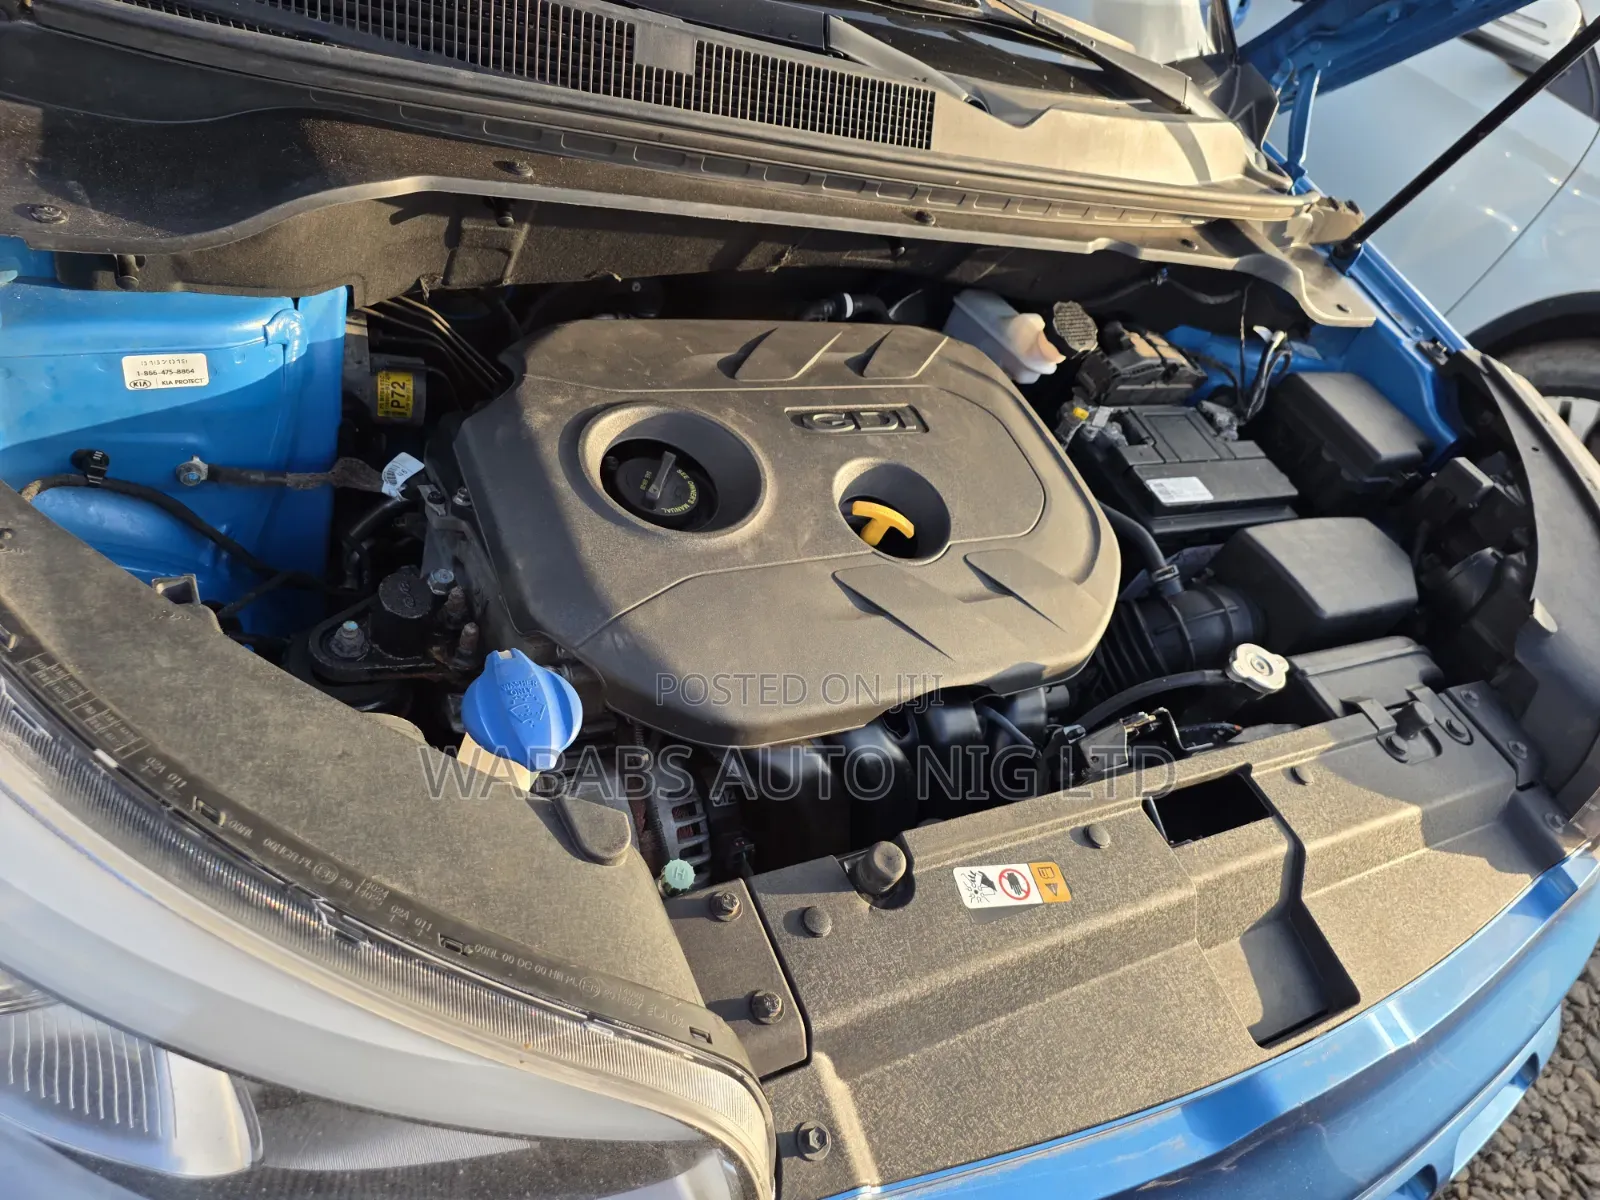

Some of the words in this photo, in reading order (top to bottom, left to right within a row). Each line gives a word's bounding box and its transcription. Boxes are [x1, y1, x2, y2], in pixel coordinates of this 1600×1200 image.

[391, 381, 405, 409] P72
[676, 469, 690, 480] SEE
[661, 503, 690, 514] MANUAL
[501, 680, 537, 691] WASHER
[510, 687, 533, 696] ONLY
[673, 866, 686, 881] H
[390, 905, 410, 921] 02A
[414, 917, 433, 932] 011
